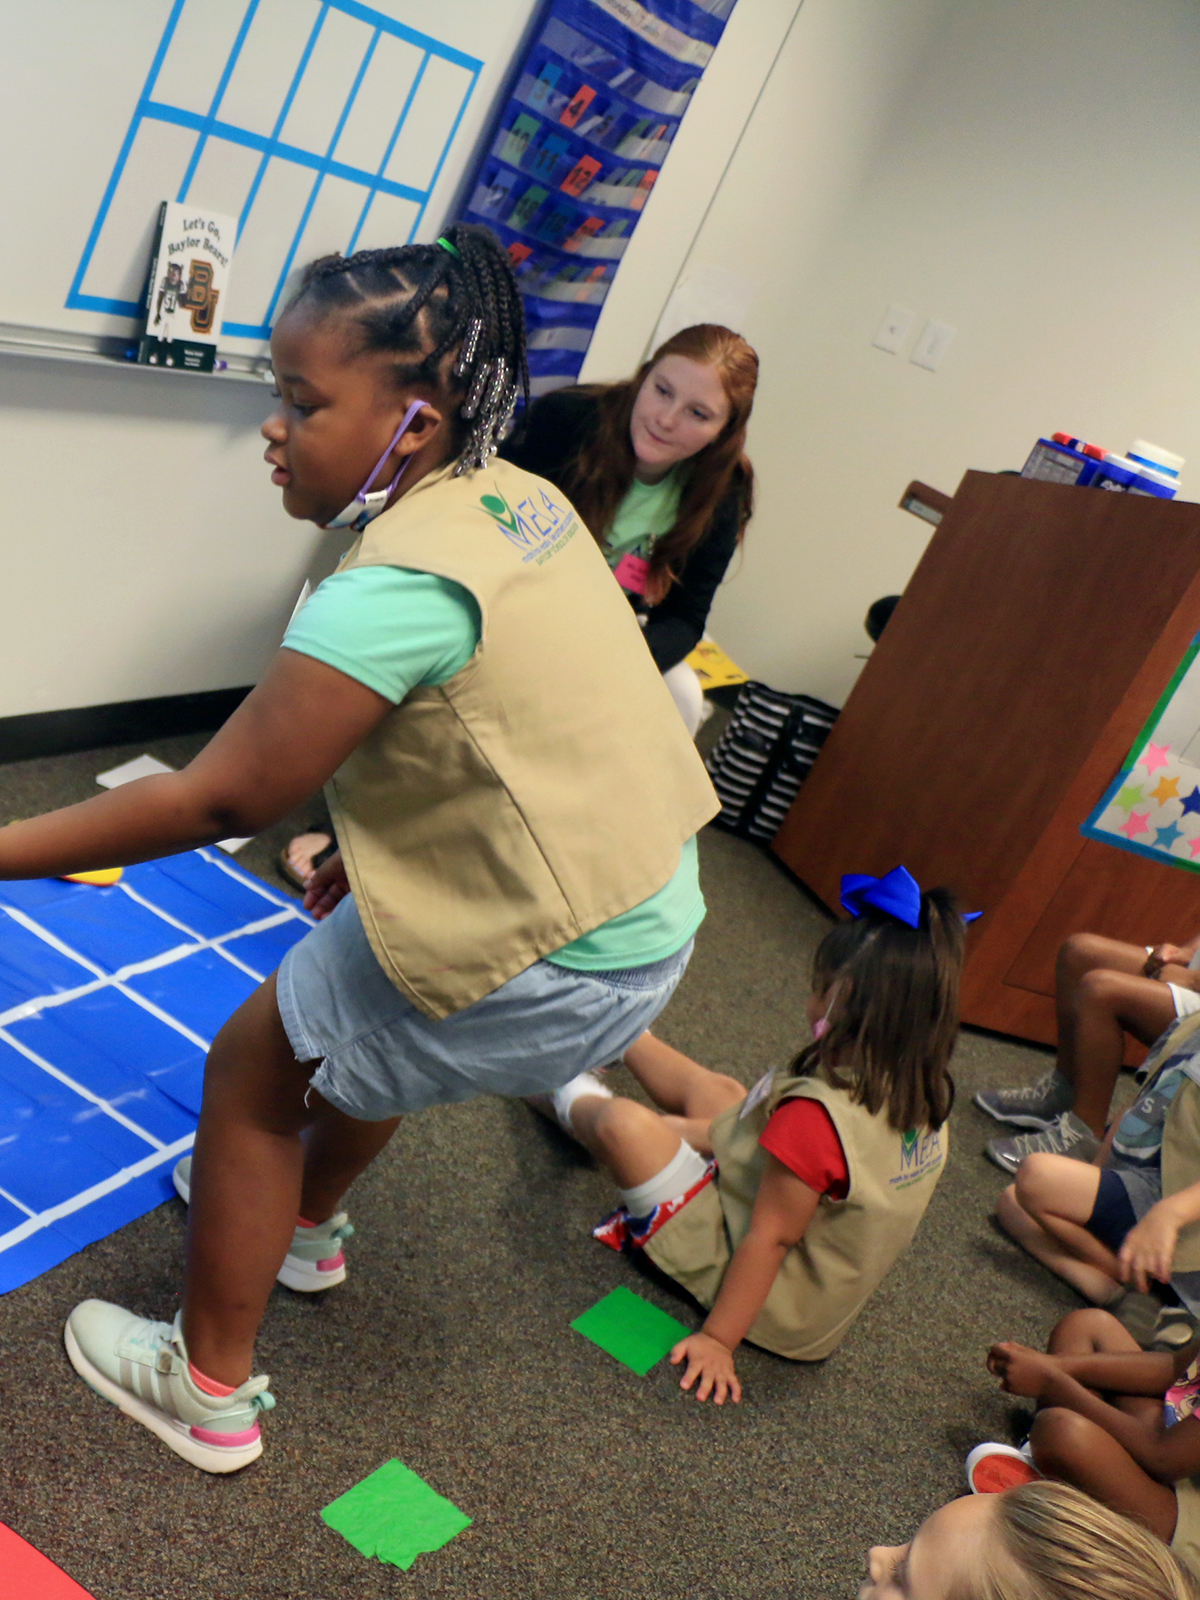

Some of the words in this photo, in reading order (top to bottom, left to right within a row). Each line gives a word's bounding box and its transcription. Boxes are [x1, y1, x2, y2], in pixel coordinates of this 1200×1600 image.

[533, 78, 549, 101] 3
[569, 99, 586, 118] 4
[597, 115, 613, 134] 5
[536, 150, 560, 173] 11
[569, 166, 592, 190] 12
[183, 218, 205, 232] Let's
[208, 221, 221, 242] Go,
[168, 236, 201, 256] Baylor
[203, 237, 229, 268] Bears!
[164, 293, 176, 310] 51
